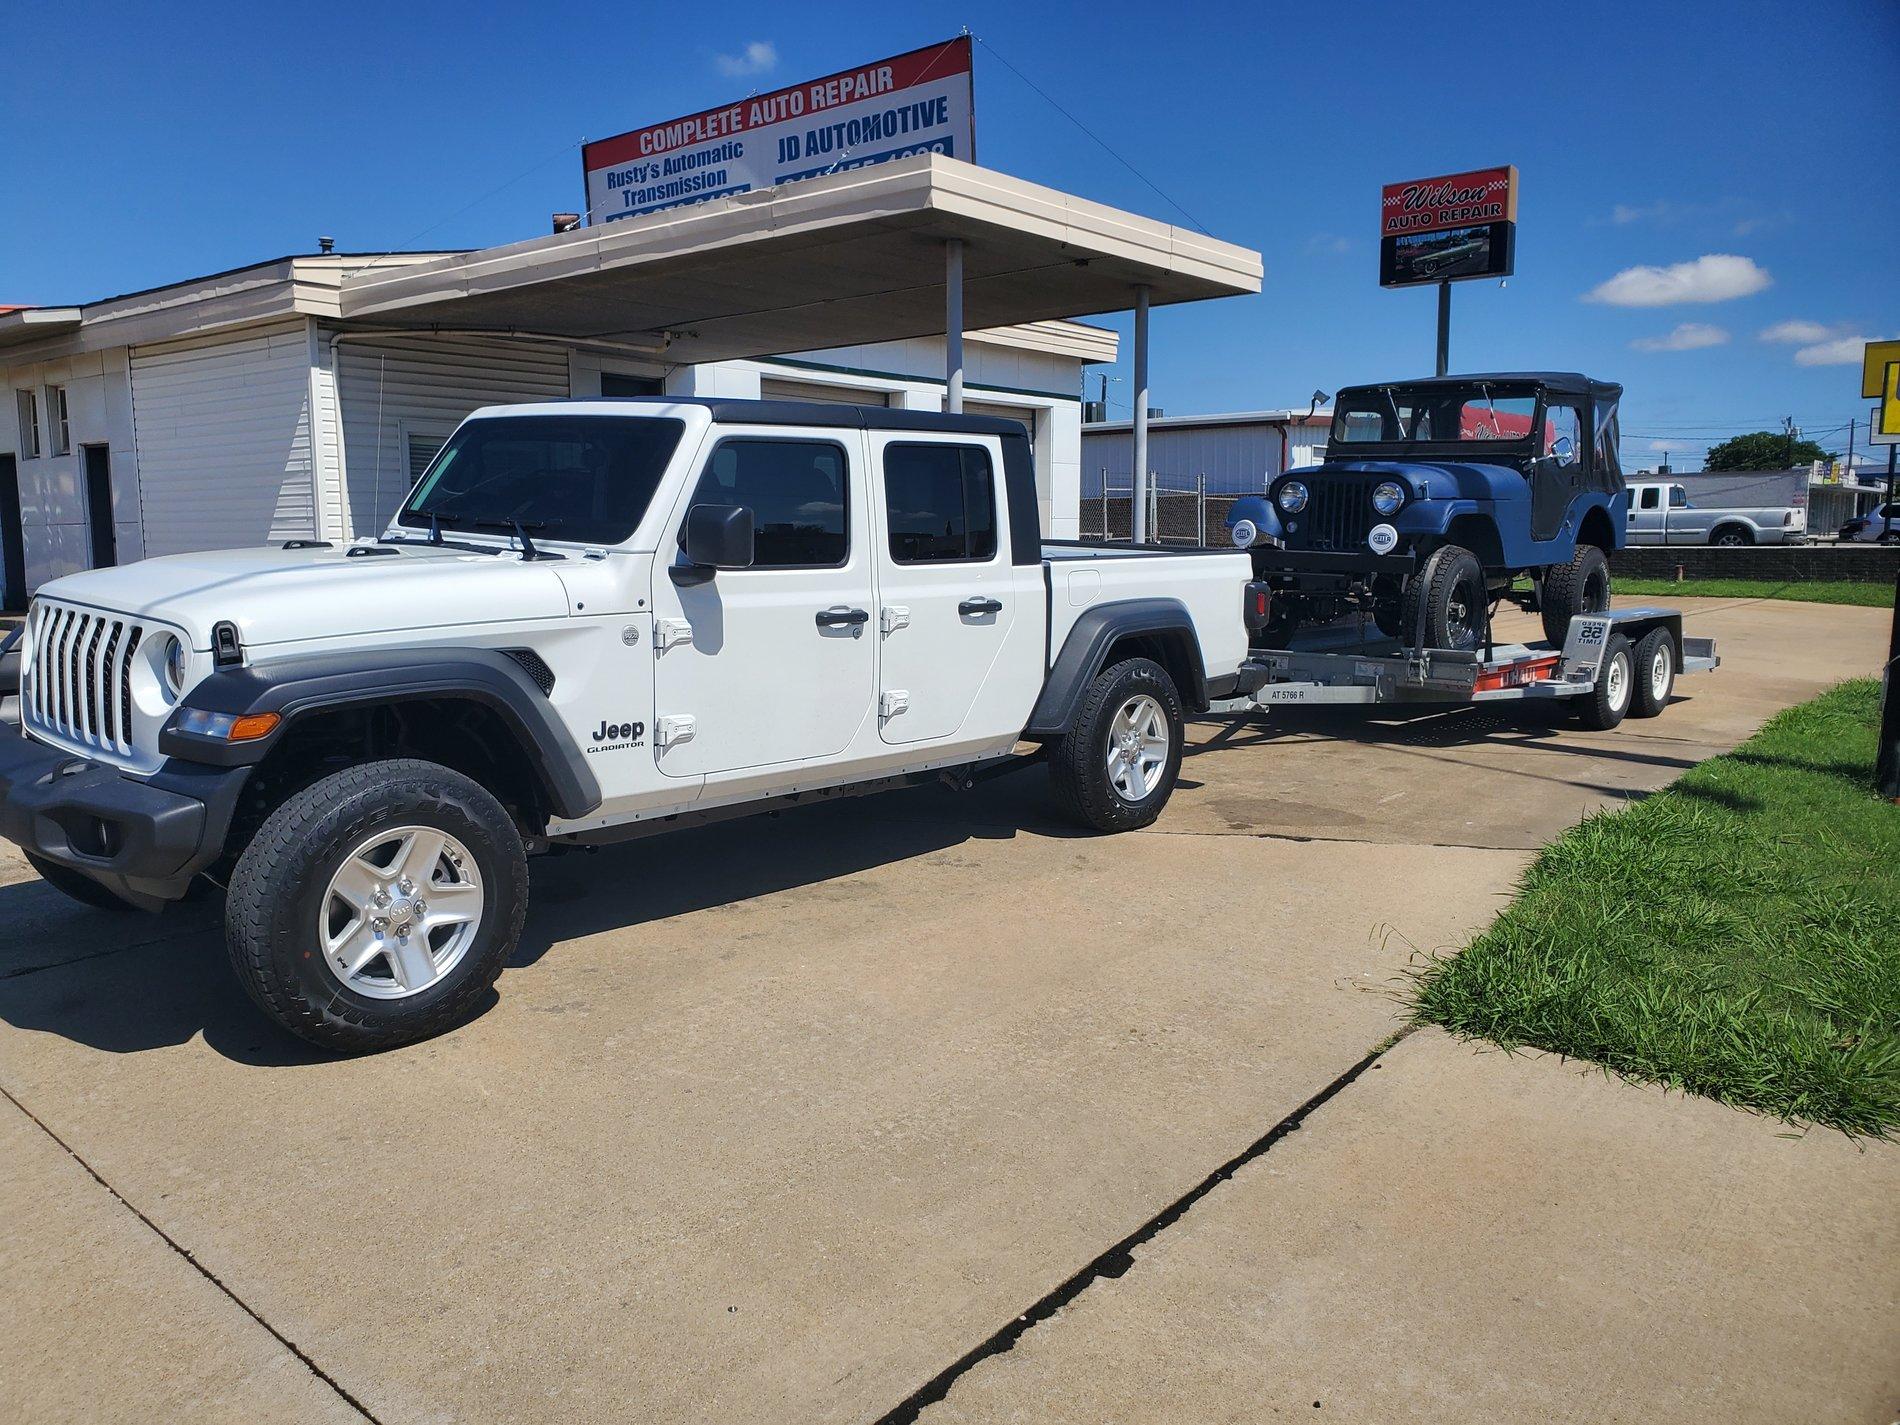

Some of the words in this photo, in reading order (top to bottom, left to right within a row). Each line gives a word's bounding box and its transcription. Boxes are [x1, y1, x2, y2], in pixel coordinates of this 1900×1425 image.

[639, 107, 743, 155] COMPLETE
[749, 89, 804, 127] AUTO
[810, 66, 894, 111] REPAIR
[777, 136, 801, 164] JD
[805, 95, 949, 158] AUTOMOTIVE
[606, 160, 661, 190] Rusty's
[662, 140, 744, 178] Automatic
[622, 168, 728, 208] Transmission
[1401, 181, 1487, 211] Wilson
[1387, 213, 1432, 231] AUTO
[1439, 203, 1503, 223] REPAIR
[1272, 691, 1281, 699] AT
[1281, 691, 1298, 699] 5766
[1299, 691, 1304, 699] R
[592, 721, 645, 741] Jeep
[587, 741, 645, 754] GLADIATOR
